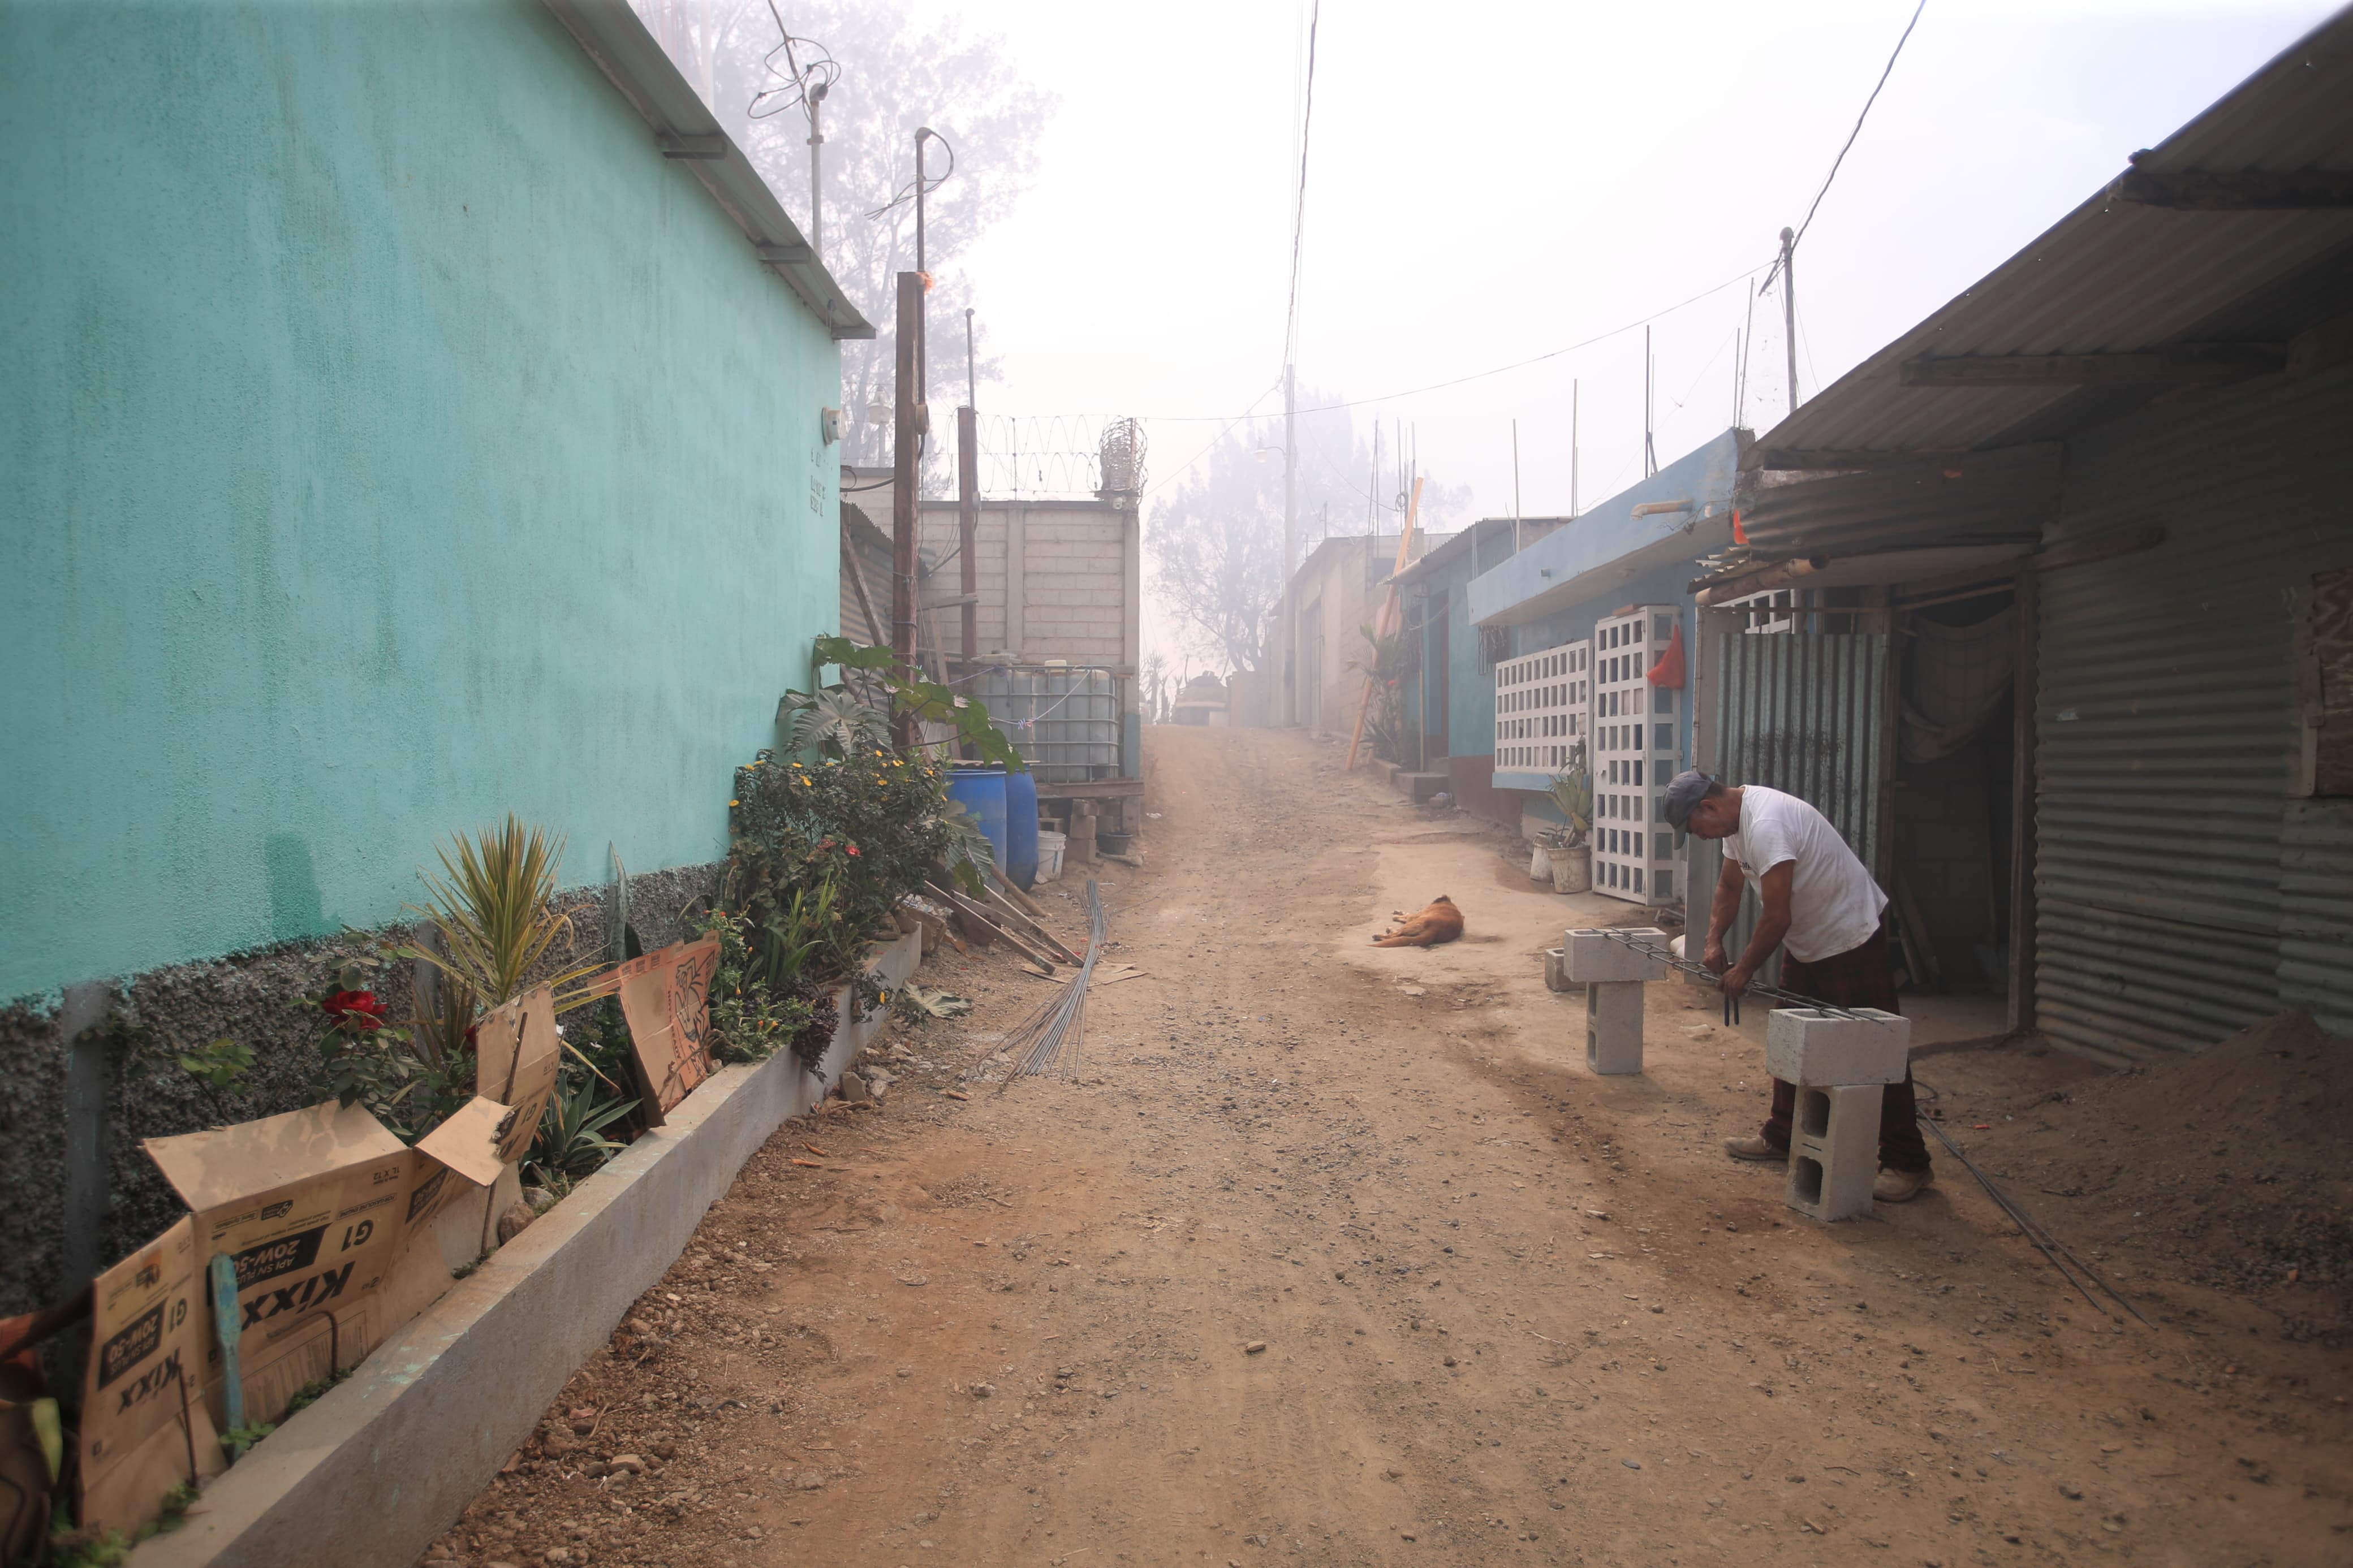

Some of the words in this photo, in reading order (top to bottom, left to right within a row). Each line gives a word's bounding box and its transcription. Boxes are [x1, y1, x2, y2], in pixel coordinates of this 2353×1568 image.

[360, 1198, 385, 1211] GASOLINE
[341, 1220, 374, 1252] G1
[257, 1264, 274, 1276] SN
[275, 1256, 295, 1269] API
[242, 1260, 356, 1332] Kixx
[169, 1298, 187, 1333] G1
[109, 1314, 159, 1363] 20W-50
[117, 1346, 180, 1416] Kixx
